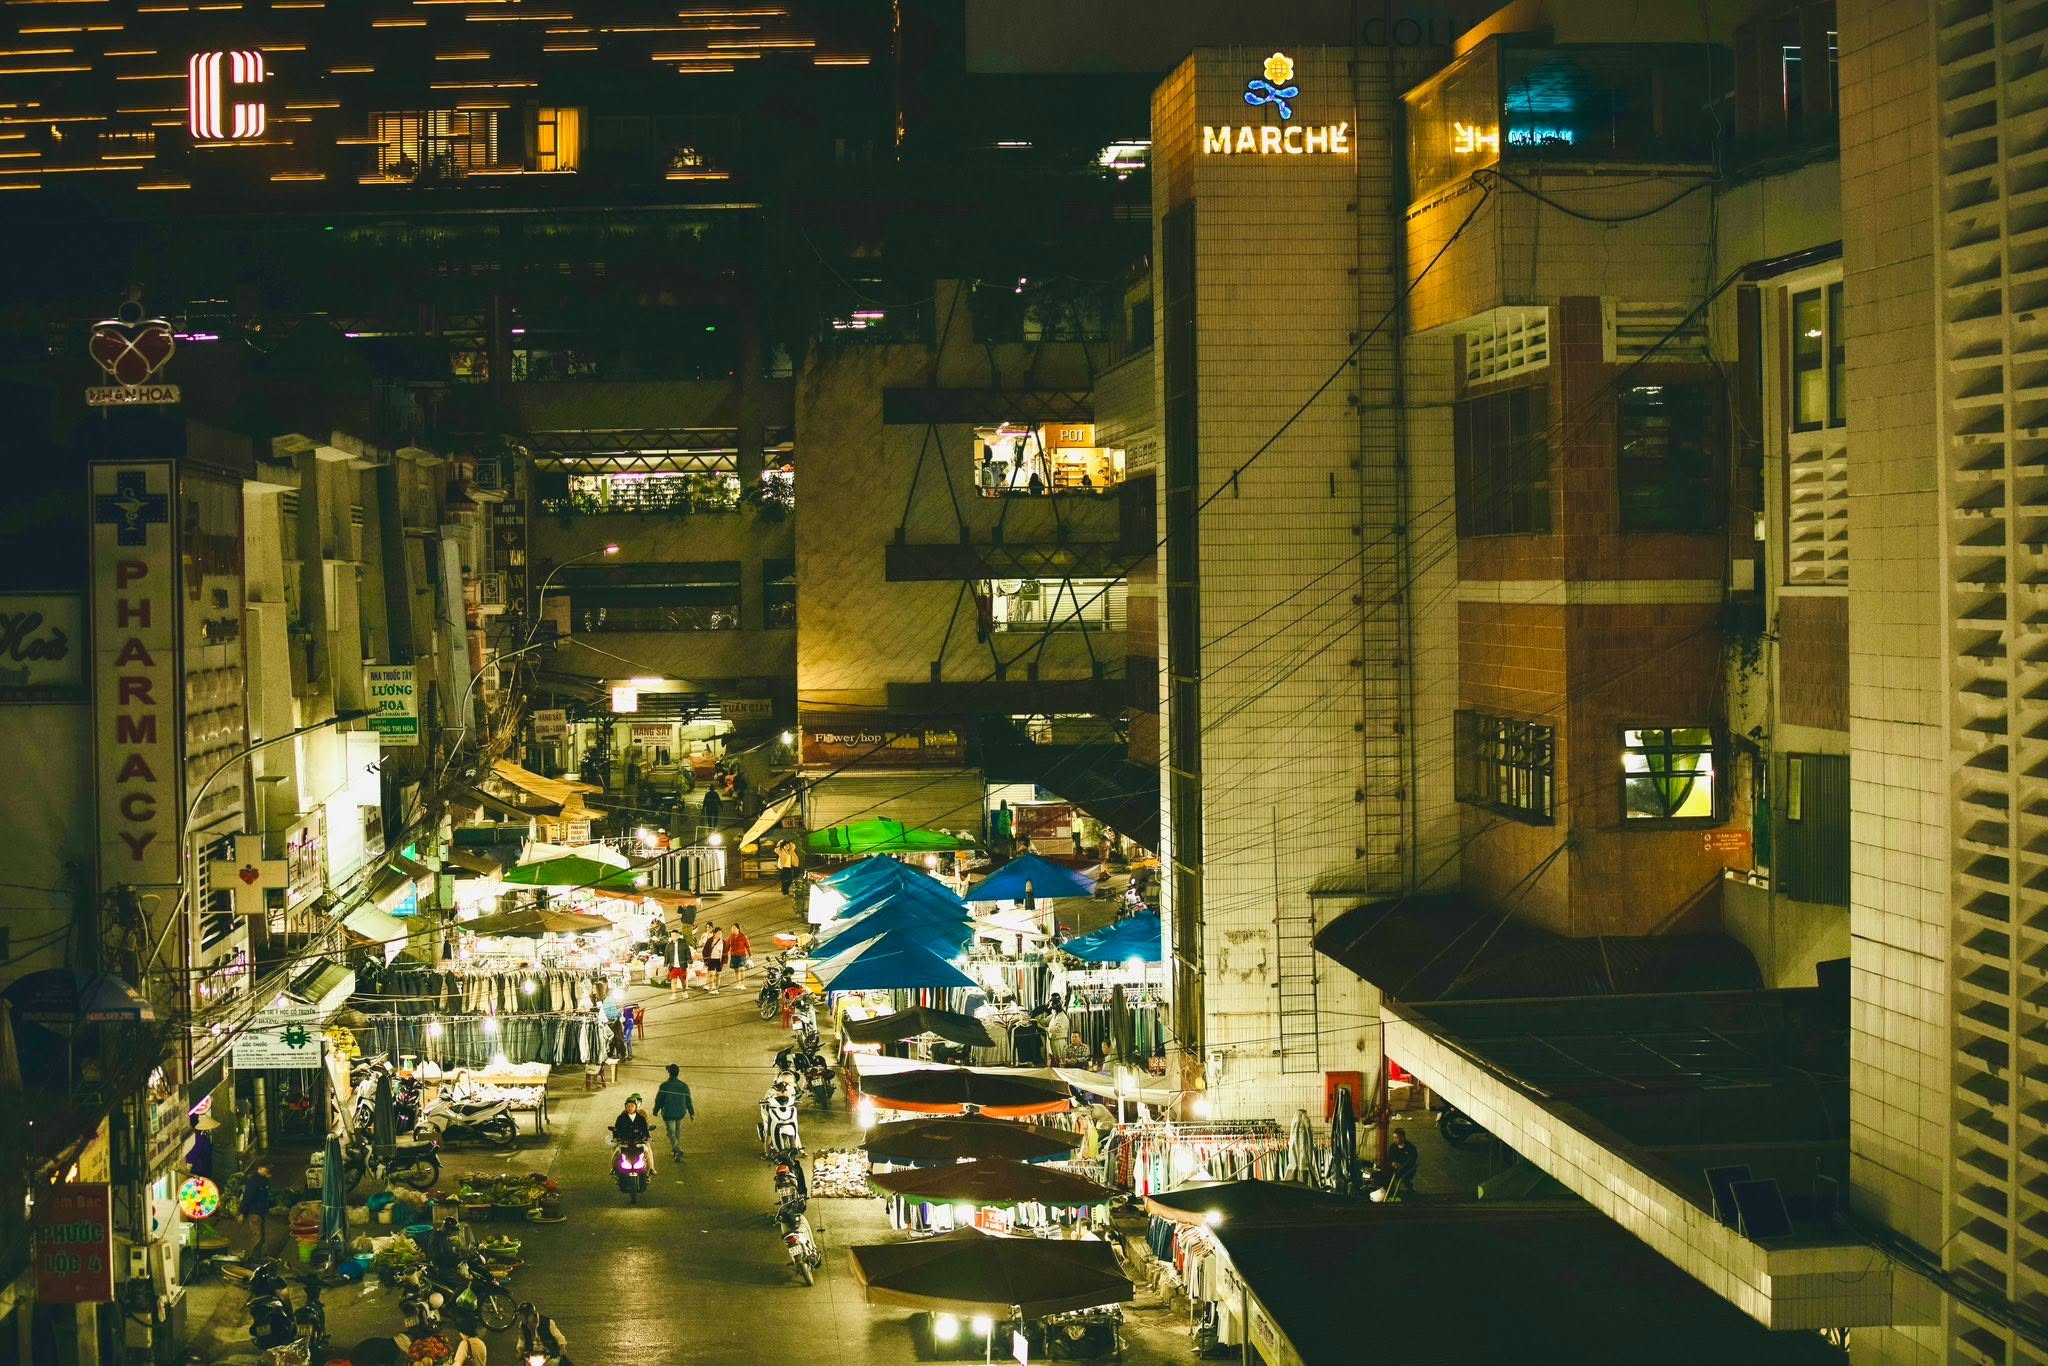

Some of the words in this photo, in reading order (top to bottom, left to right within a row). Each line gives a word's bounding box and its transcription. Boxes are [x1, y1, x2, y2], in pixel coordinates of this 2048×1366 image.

[1203, 122, 1349, 154] MARCHÉ
[1060, 429, 1086, 442] POT
[371, 683, 413, 697] LƯƠNG
[115, 559, 158, 862] PHARMACY
